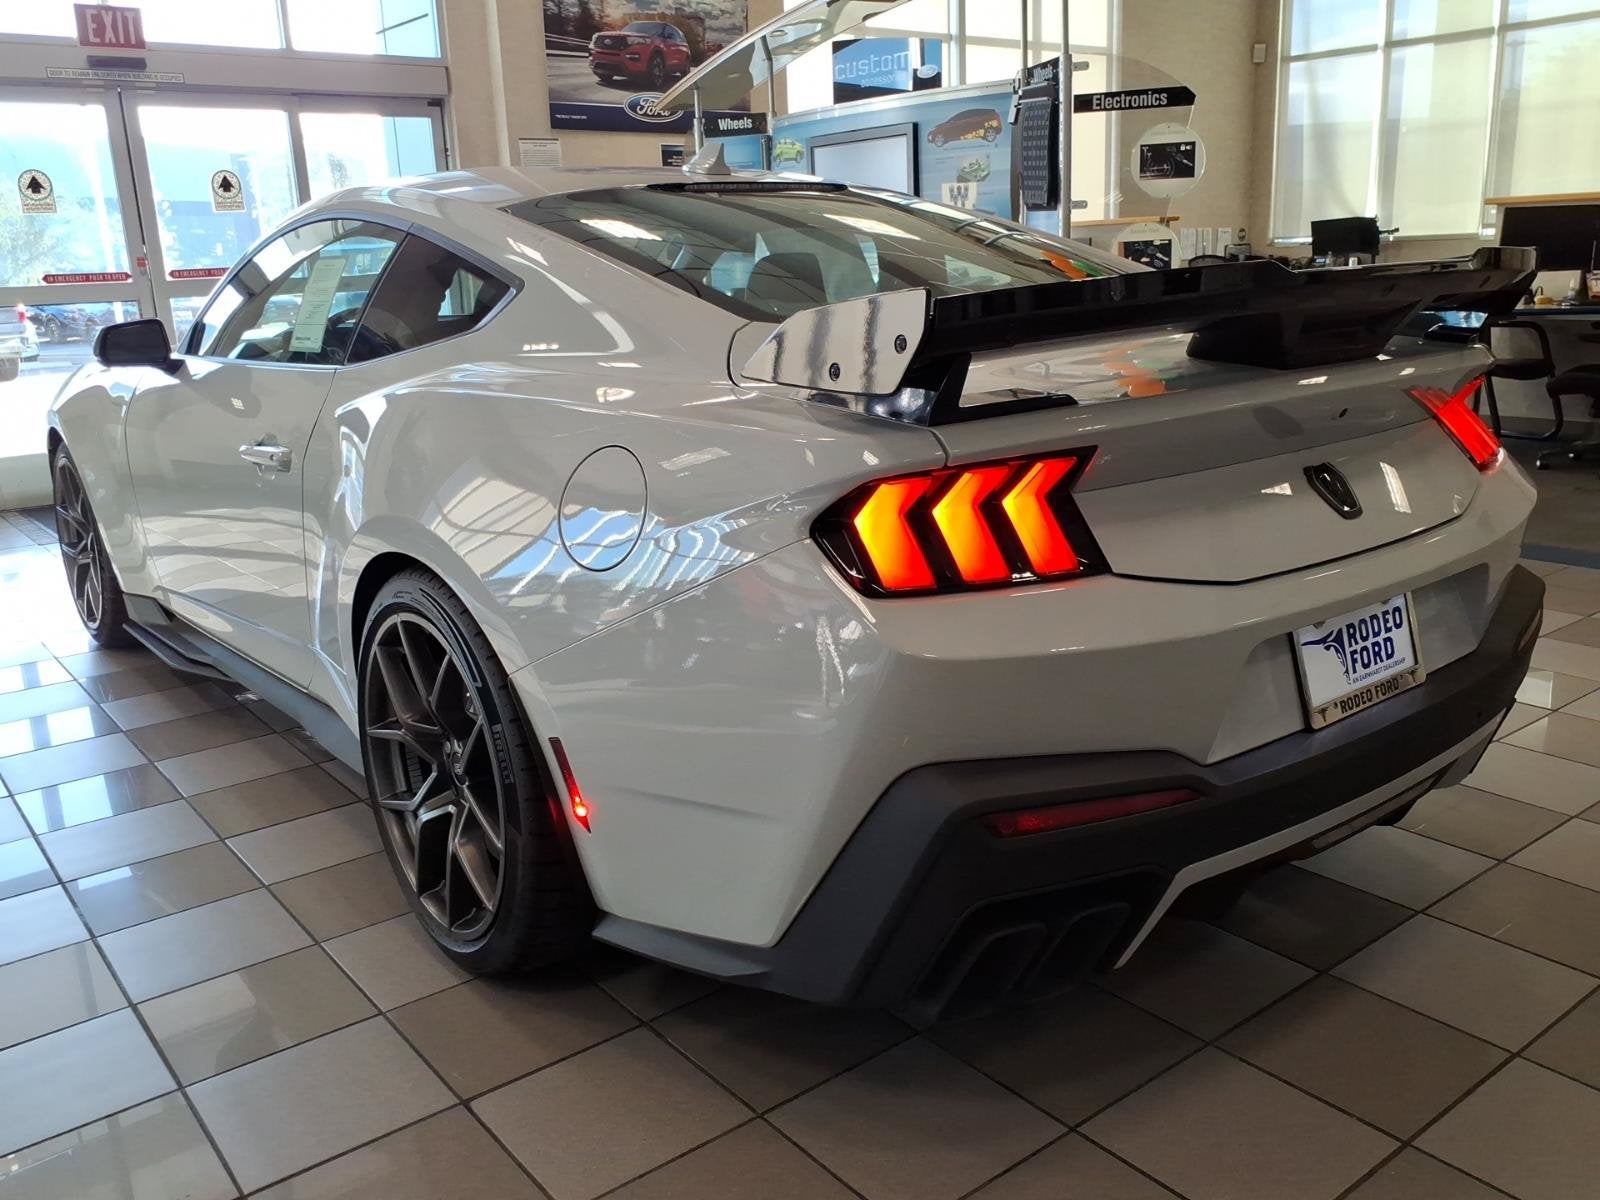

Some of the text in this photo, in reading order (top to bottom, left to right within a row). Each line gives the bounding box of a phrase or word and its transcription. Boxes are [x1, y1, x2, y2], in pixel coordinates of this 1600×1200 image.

[84, 9, 136, 45] EXIT
[834, 51, 910, 80] custom
[1033, 66, 1053, 83] Wheels
[1092, 91, 1168, 110] Electronics
[718, 117, 752, 131] Wheels
[1345, 606, 1404, 648] RODEO
[1349, 636, 1395, 675] FORD
[1352, 657, 1406, 684] AN EARNHARDT DEALERSHIP
[1340, 678, 1399, 714] RODEO FORD
